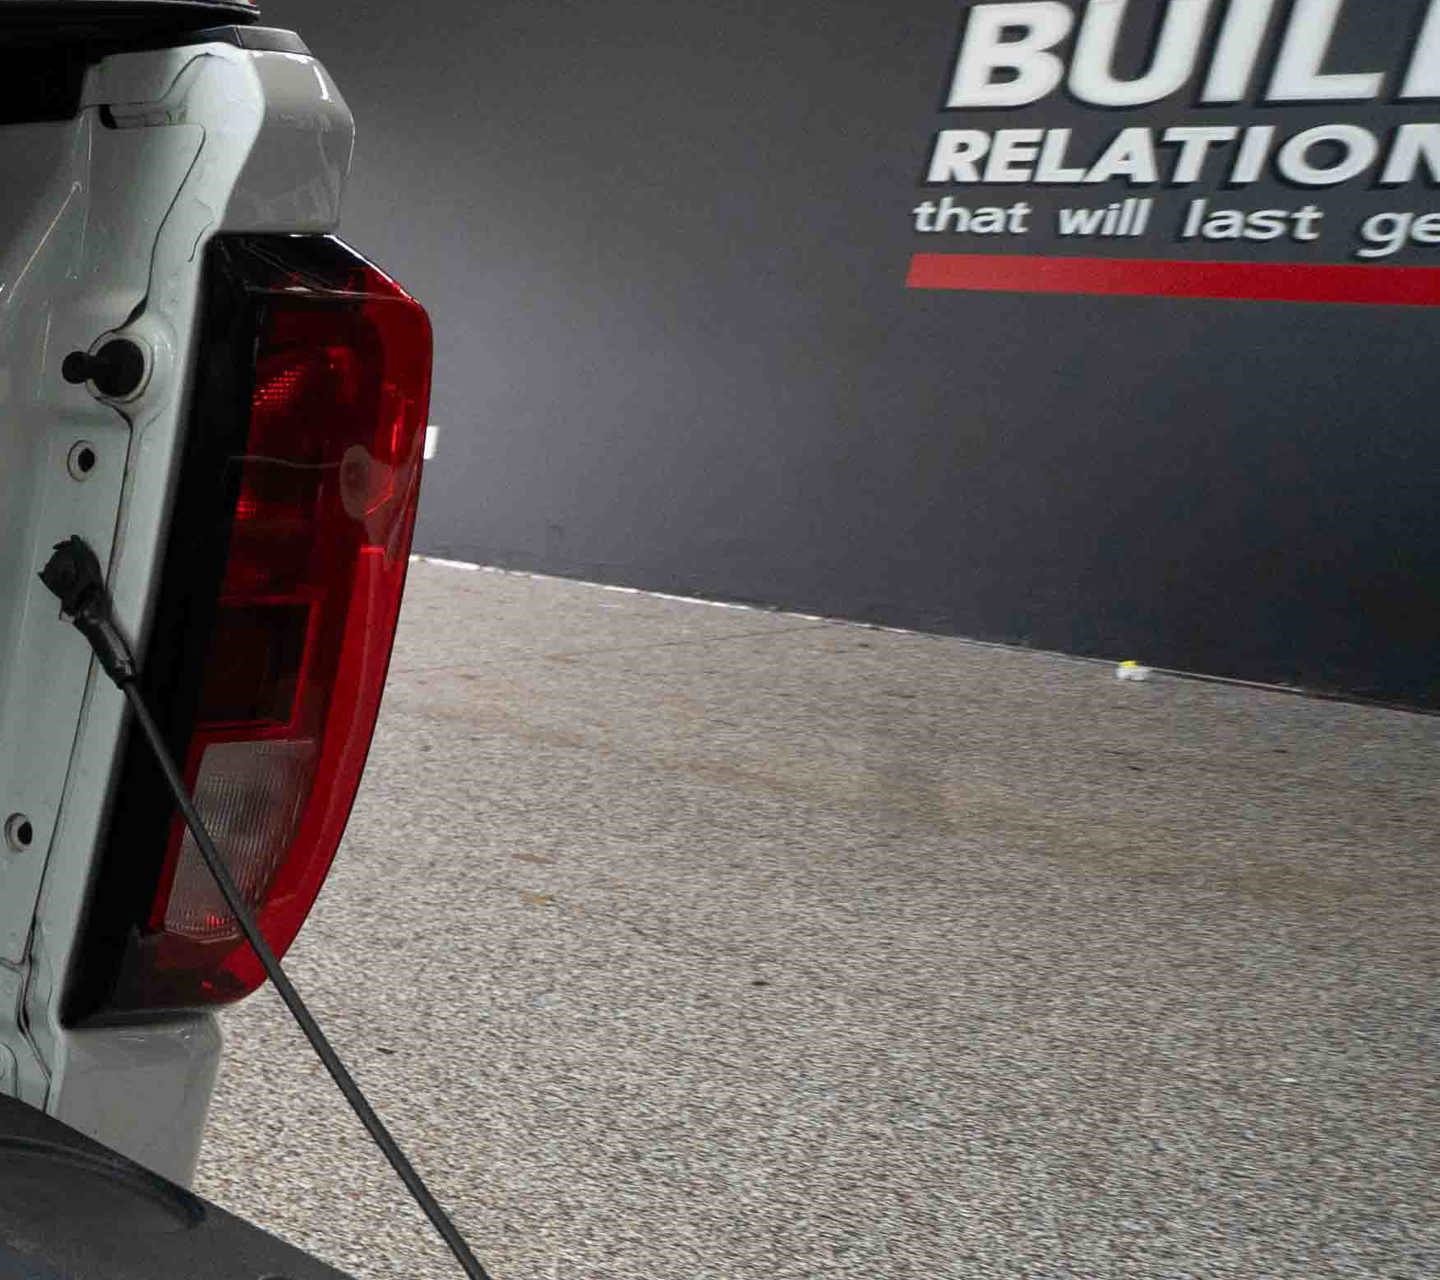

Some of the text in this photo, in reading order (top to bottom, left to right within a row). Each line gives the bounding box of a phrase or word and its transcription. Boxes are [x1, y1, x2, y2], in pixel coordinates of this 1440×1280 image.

[913, 198, 1032, 236] that
[1059, 198, 1153, 237] will
[1182, 199, 1323, 240] last
